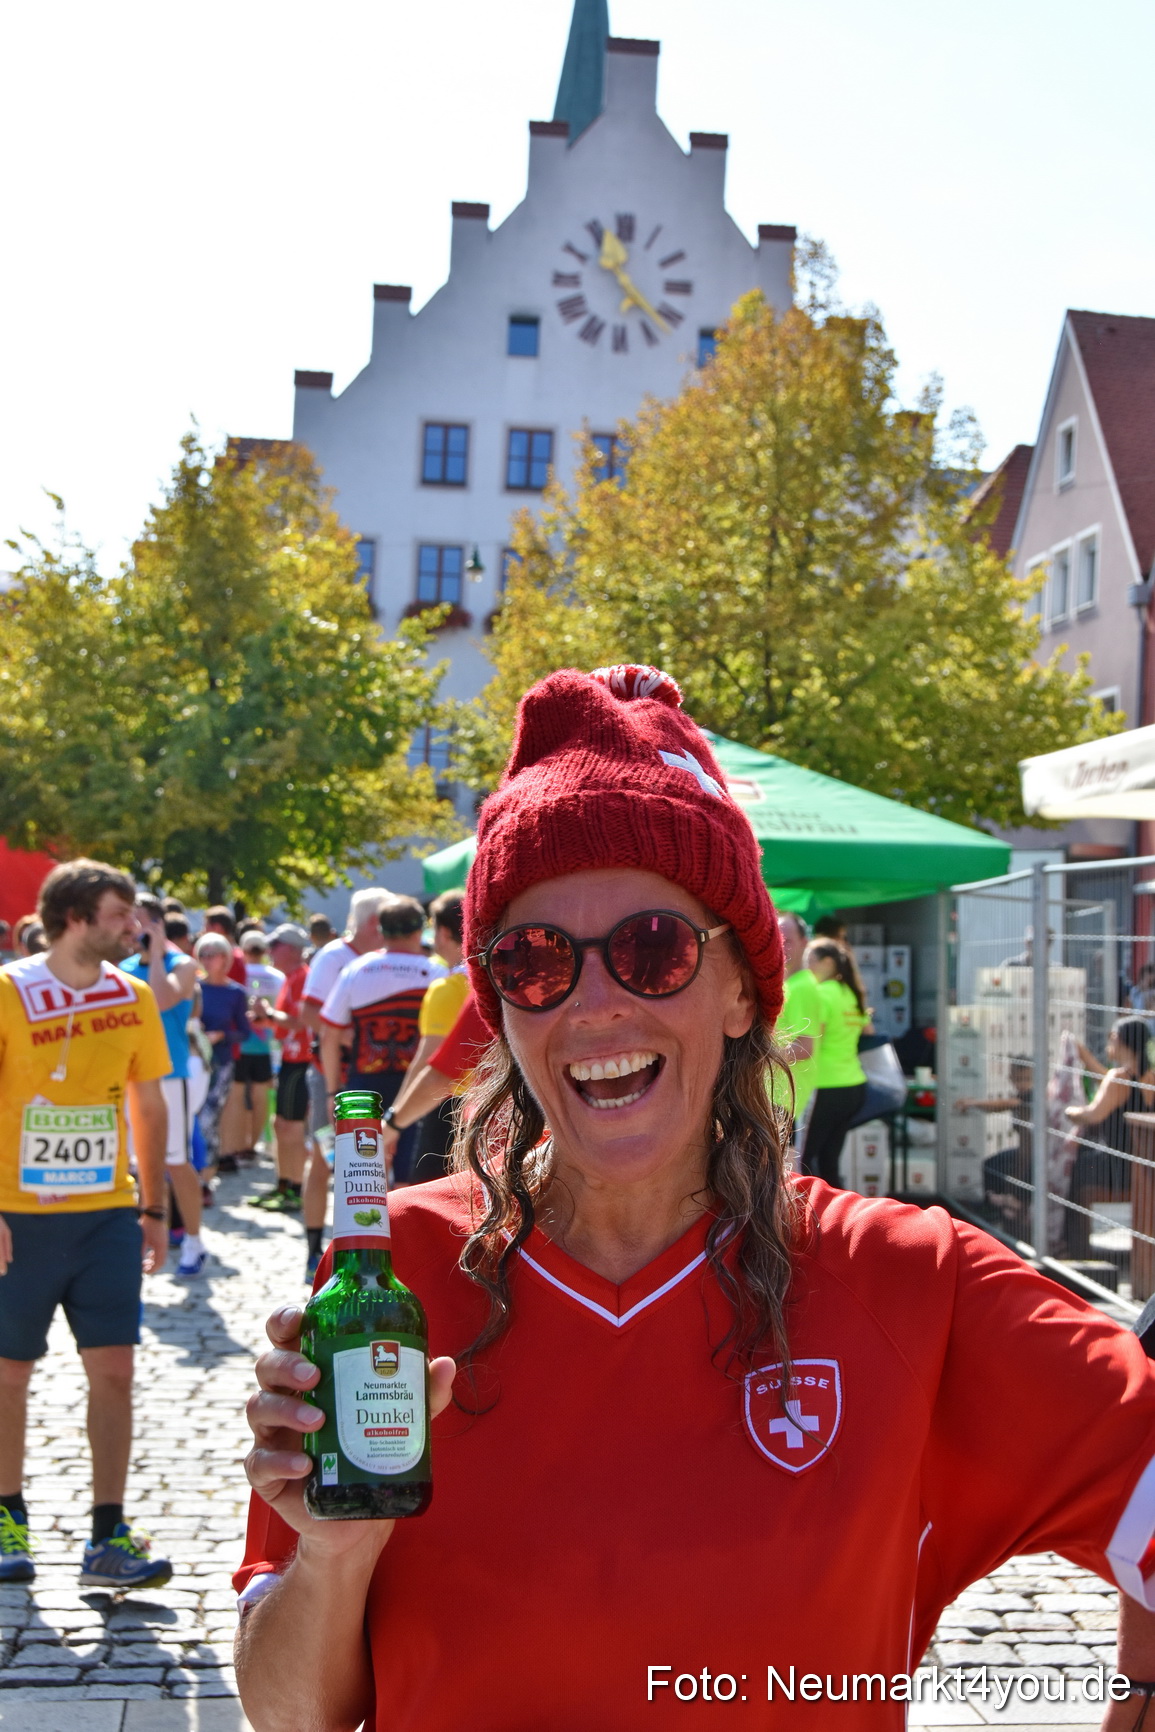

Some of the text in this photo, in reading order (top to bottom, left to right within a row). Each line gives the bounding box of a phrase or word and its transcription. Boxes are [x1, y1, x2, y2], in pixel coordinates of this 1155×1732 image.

[31, 1011, 143, 1047] MAX BÖGL
[30, 1109, 111, 1130] BOCK
[34, 1137, 107, 1163] 2401
[43, 1170, 98, 1184] MARCO
[364, 1381, 407, 1389] Neumarkter
[756, 1376, 830, 1395] SUSSE
[356, 1390, 414, 1401] Lammsbräu
[356, 1408, 414, 1425] Dunkel
